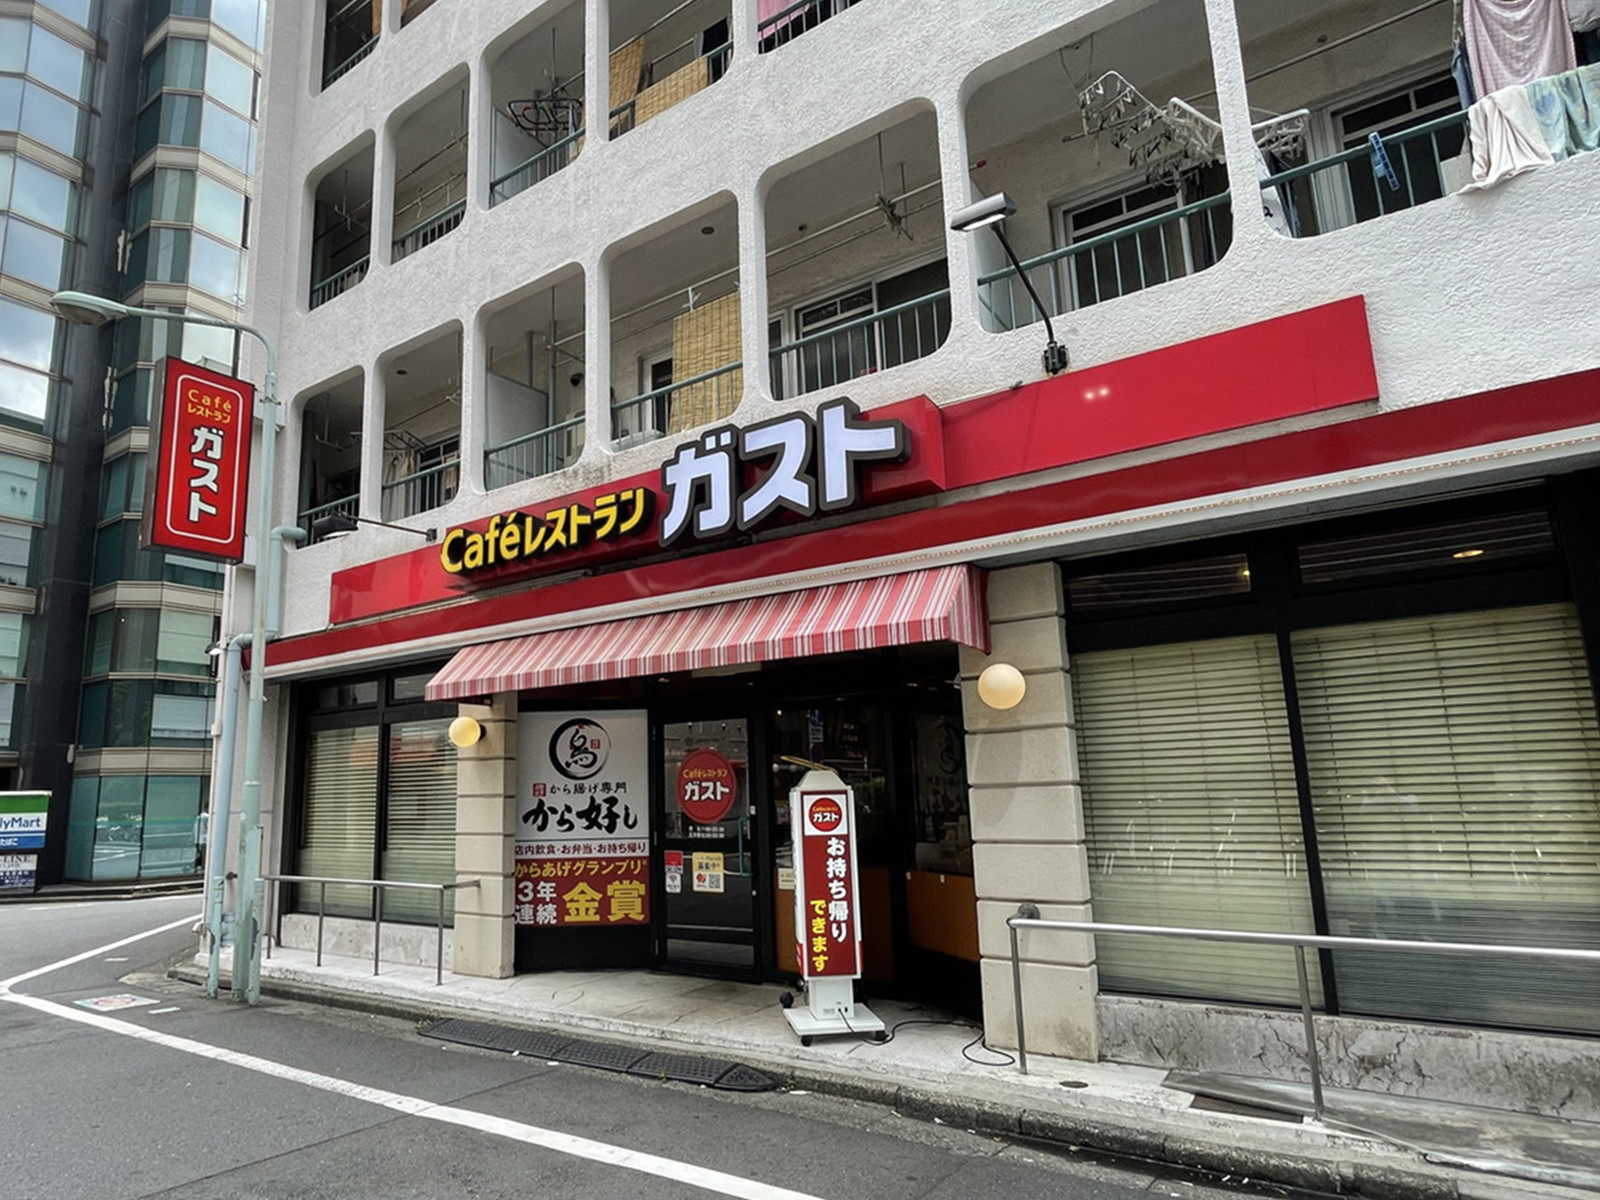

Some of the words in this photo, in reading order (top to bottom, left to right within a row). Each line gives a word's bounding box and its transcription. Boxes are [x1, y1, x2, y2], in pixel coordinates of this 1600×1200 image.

[187, 402, 231, 424] レストラン
[188, 389, 232, 413] Café
[188, 426, 224, 523] ガスト
[660, 402, 897, 542] ガスト
[549, 781, 627, 795] から揚げ専門
[684, 780, 730, 801] ガスト
[522, 795, 638, 834] から好し
[813, 812, 839, 823] ガスト
[517, 881, 557, 902] 3年
[562, 880, 646, 922] 金賞
[826, 837, 849, 943] お持ち帰り
[514, 903, 557, 925] 連続
[810, 899, 829, 972] できます
